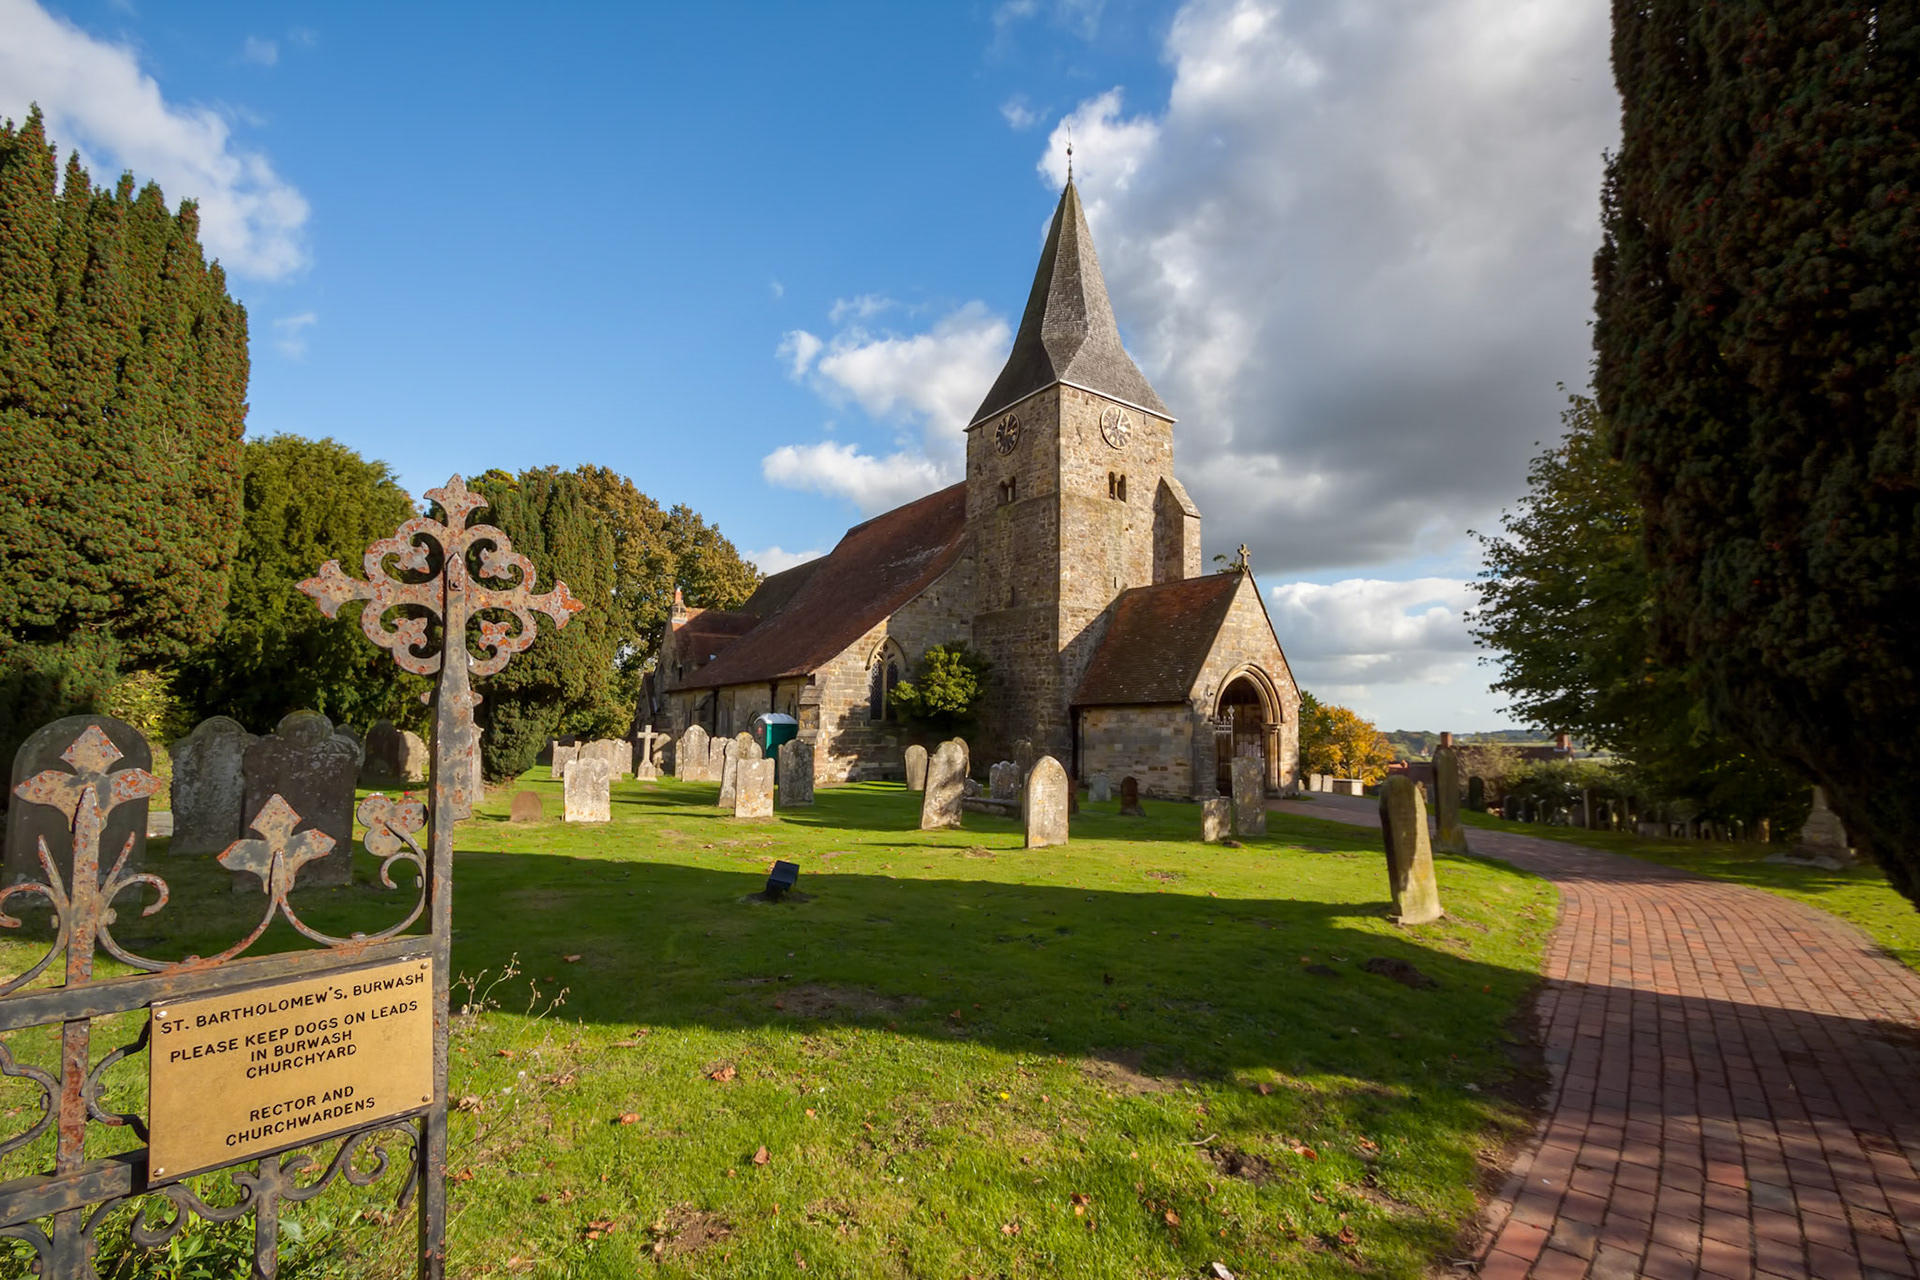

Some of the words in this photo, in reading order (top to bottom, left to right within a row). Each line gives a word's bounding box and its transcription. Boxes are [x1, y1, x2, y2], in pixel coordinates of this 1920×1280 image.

[161, 1018, 190, 1034] ST.
[353, 973, 424, 996] BURWASH
[170, 1038, 238, 1062] PLEASE
[245, 1027, 289, 1046] KEEP
[295, 1017, 338, 1035] DOGS
[344, 1011, 365, 1025] ON
[371, 1000, 418, 1019] LEADS
[251, 1049, 267, 1062] IN
[274, 1030, 352, 1057] BURWASH
[246, 1044, 357, 1079] CHURCHYARD
[226, 1097, 375, 1146] CHURCHWARDENS
[250, 1095, 316, 1121] RECTOR
[321, 1086, 354, 1103] AND
